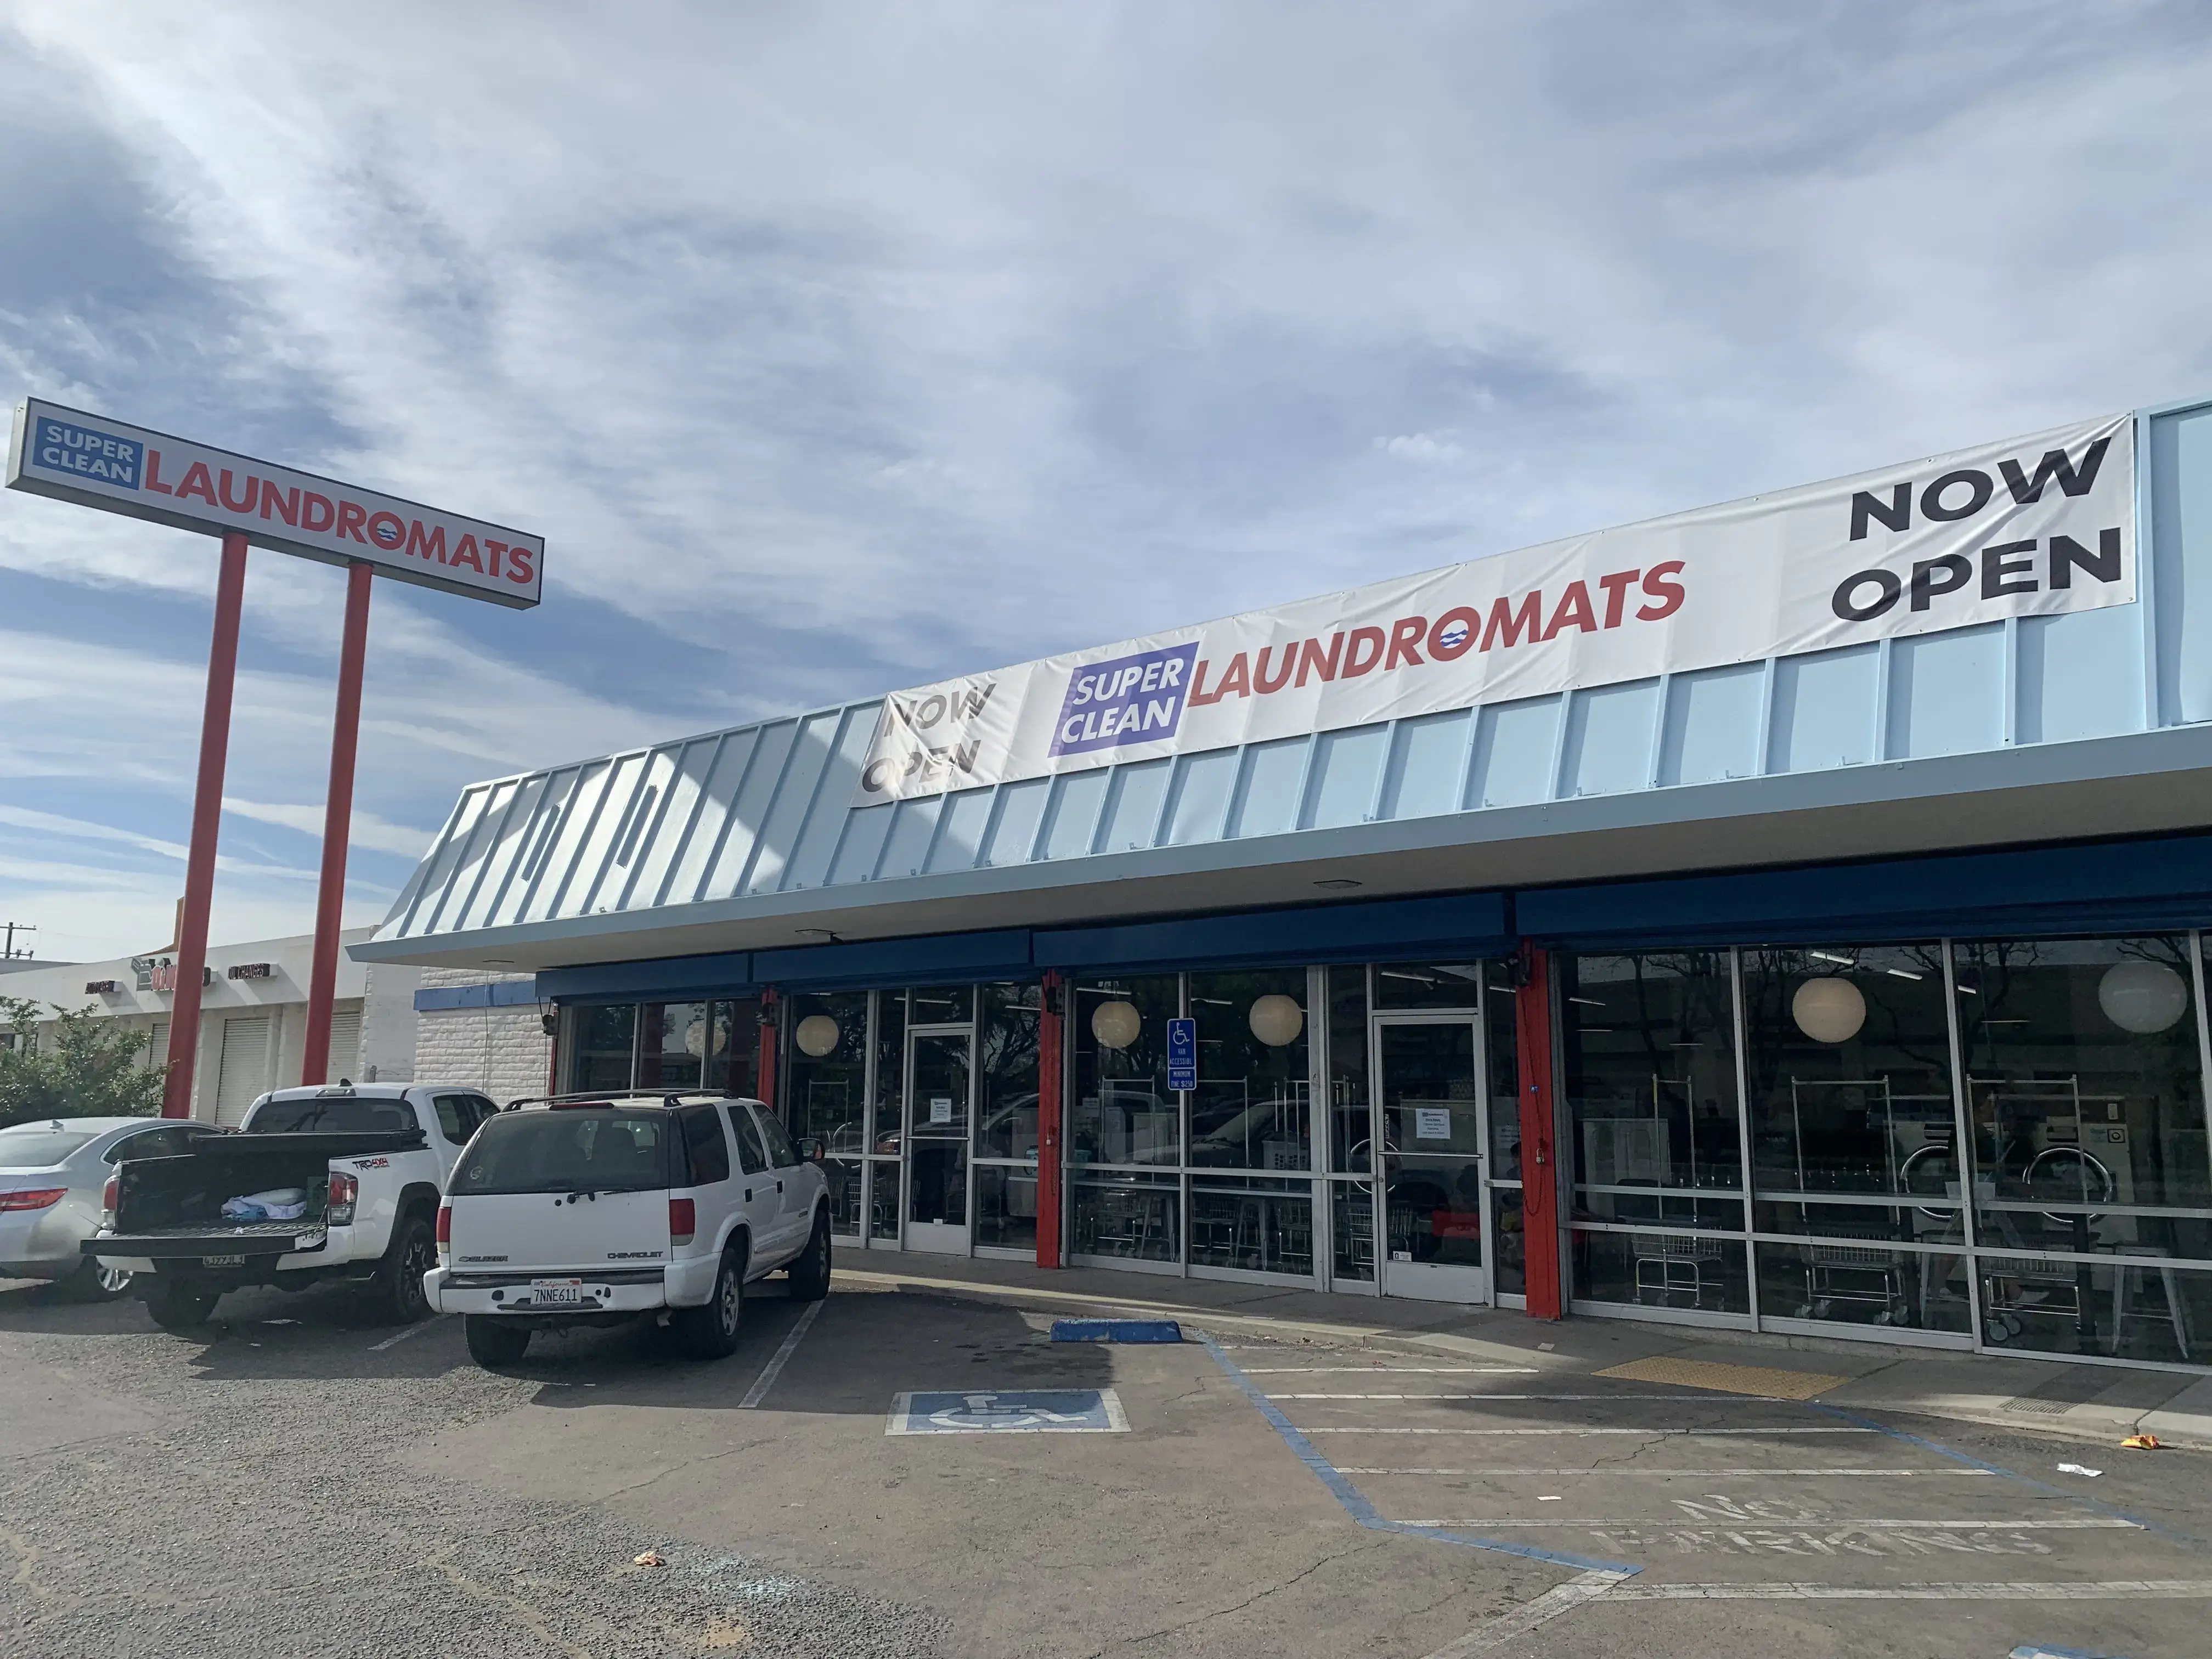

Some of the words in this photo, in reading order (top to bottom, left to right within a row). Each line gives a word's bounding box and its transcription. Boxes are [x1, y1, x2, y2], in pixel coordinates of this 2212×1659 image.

[42, 447, 132, 483] CLEAN
[46, 425, 134, 462] SUPER
[1849, 437, 2112, 541] NOW
[145, 449, 533, 584] LAUNDROMATS
[1832, 527, 2121, 622] OPEN
[1188, 561, 1686, 708] LAUNDROMATS
[1072, 658, 1184, 705] SUPER
[884, 683, 997, 737] NOW
[1062, 696, 1176, 743] CLEAN
[862, 740, 981, 792] OPEN
[237, 963, 264, 979] CHANGES
[534, 1288, 577, 1302] 7NNE611
[1670, 1493, 1830, 1520] NO
